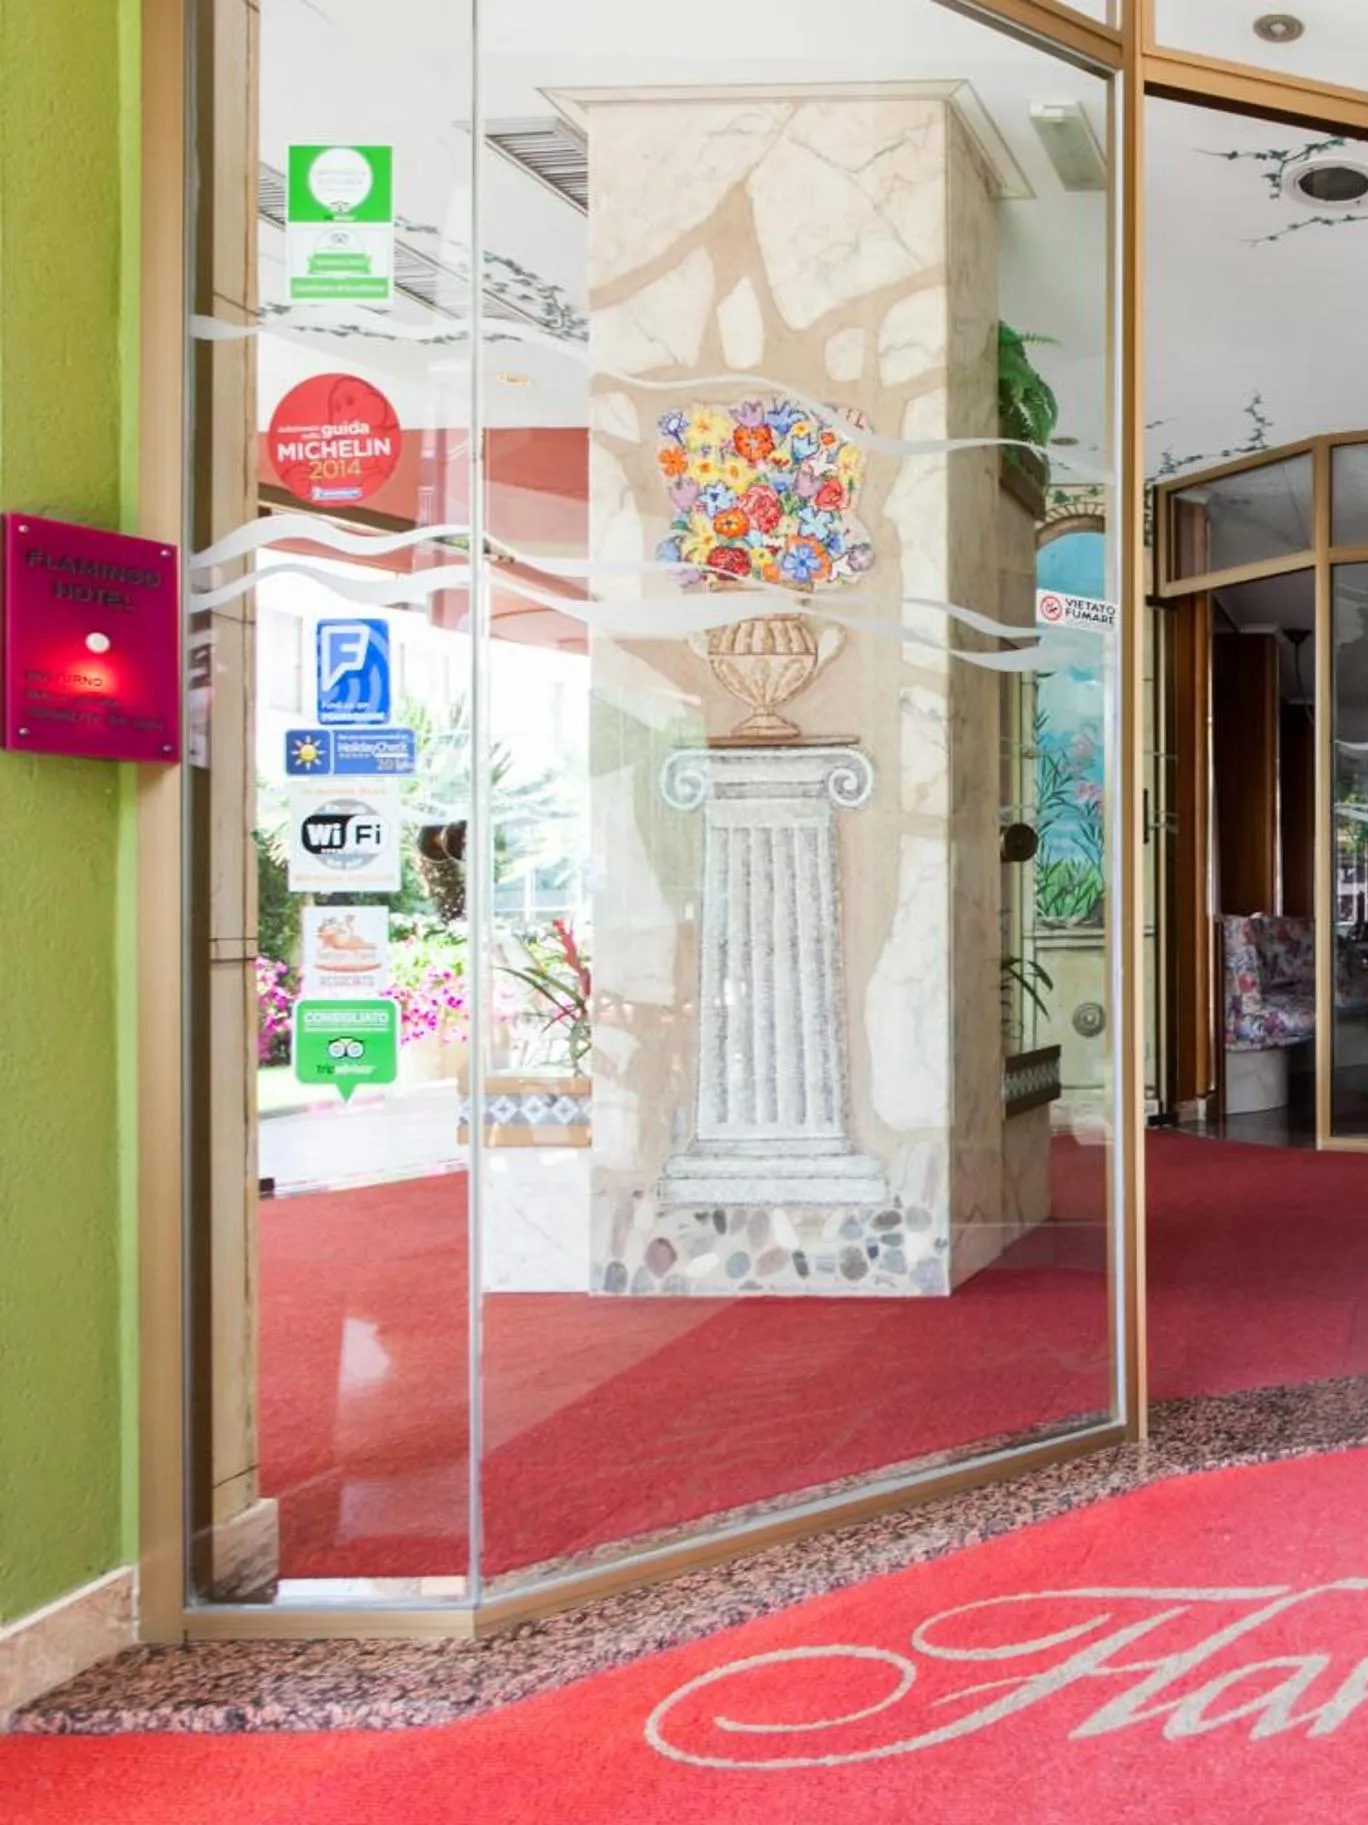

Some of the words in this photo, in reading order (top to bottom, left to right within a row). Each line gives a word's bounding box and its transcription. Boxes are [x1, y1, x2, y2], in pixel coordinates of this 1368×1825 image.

[321, 421, 370, 438] guida
[277, 438, 391, 462] MICHELIN
[308, 459, 362, 479] 2014
[28, 549, 161, 588] FLAMINGO
[54, 580, 134, 611] HOTEL
[1065, 598, 1116, 615] VIETATO
